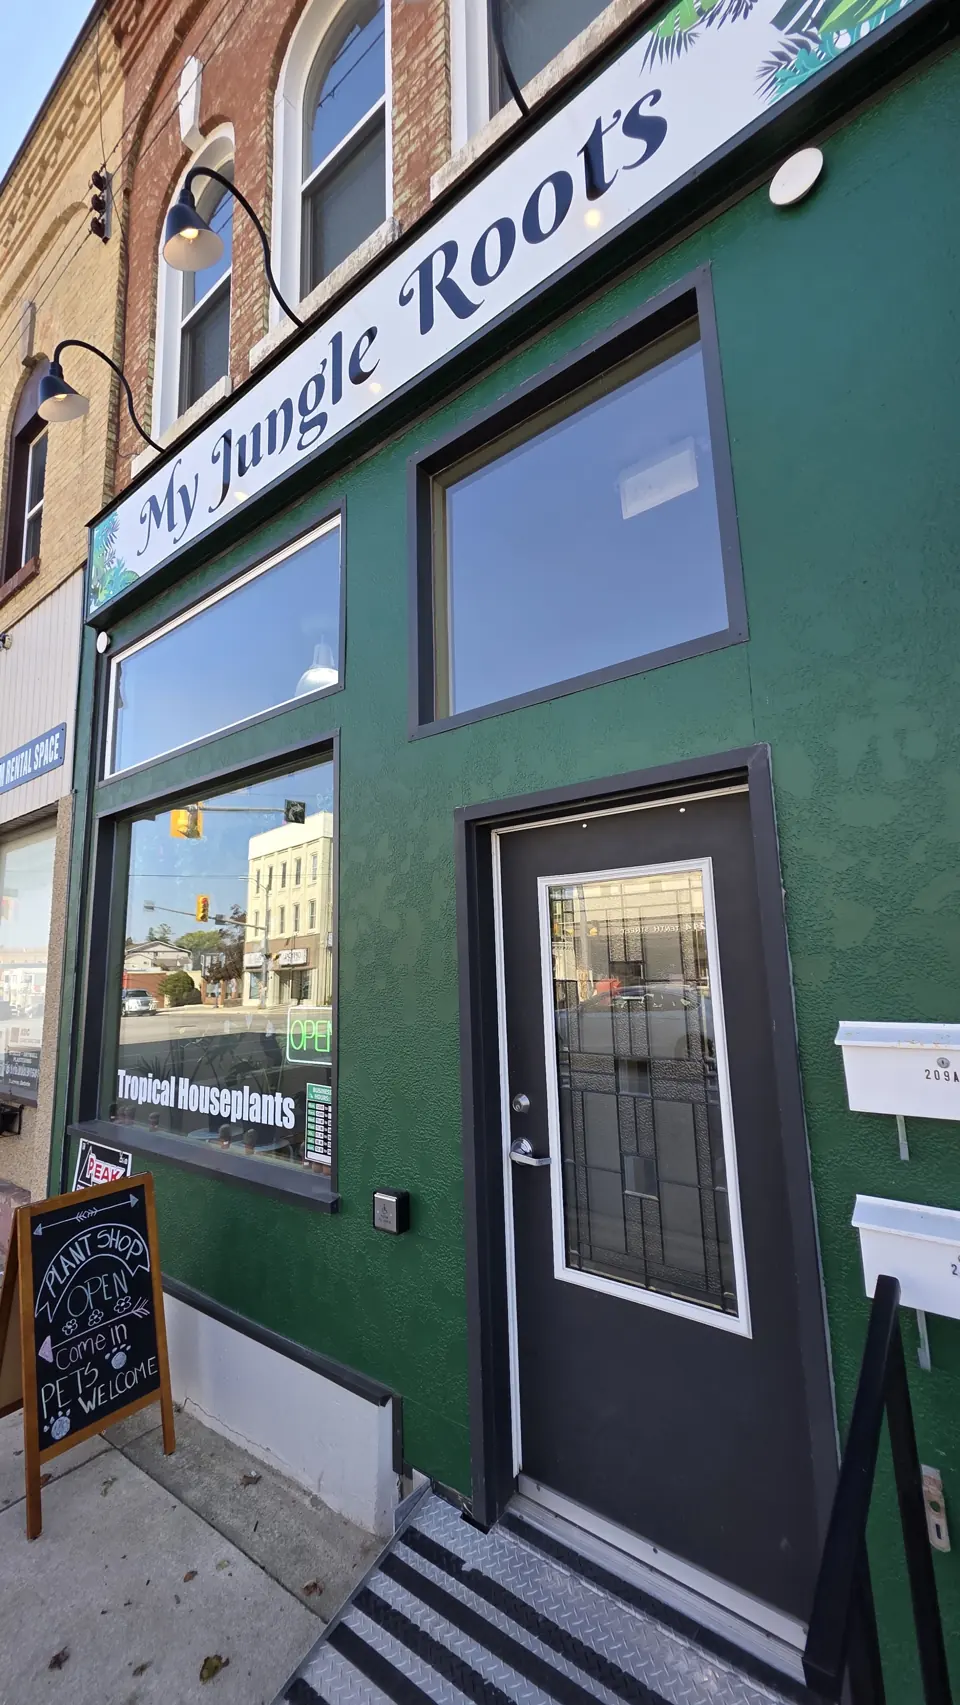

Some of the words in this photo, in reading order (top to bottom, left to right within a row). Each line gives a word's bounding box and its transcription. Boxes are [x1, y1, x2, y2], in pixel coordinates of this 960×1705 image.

[137, 458, 199, 556] My
[208, 326, 380, 513] Jungle
[398, 88, 668, 336] Roots
[5, 748, 32, 785] RENTAL
[33, 732, 60, 771] SPACE
[118, 1069, 175, 1108] Tropical
[178, 1077, 295, 1130] Houseplants
[924, 1069, 960, 1083] 209A
[87, 1155, 122, 1182] PEAK
[45, 1233, 92, 1298] PLANT
[96, 1228, 144, 1260] SHOP
[67, 1269, 129, 1317] OPEN
[108, 1323, 128, 1346] in
[41, 1361, 99, 1419] PETS
[77, 1356, 158, 1414] WELCOME
